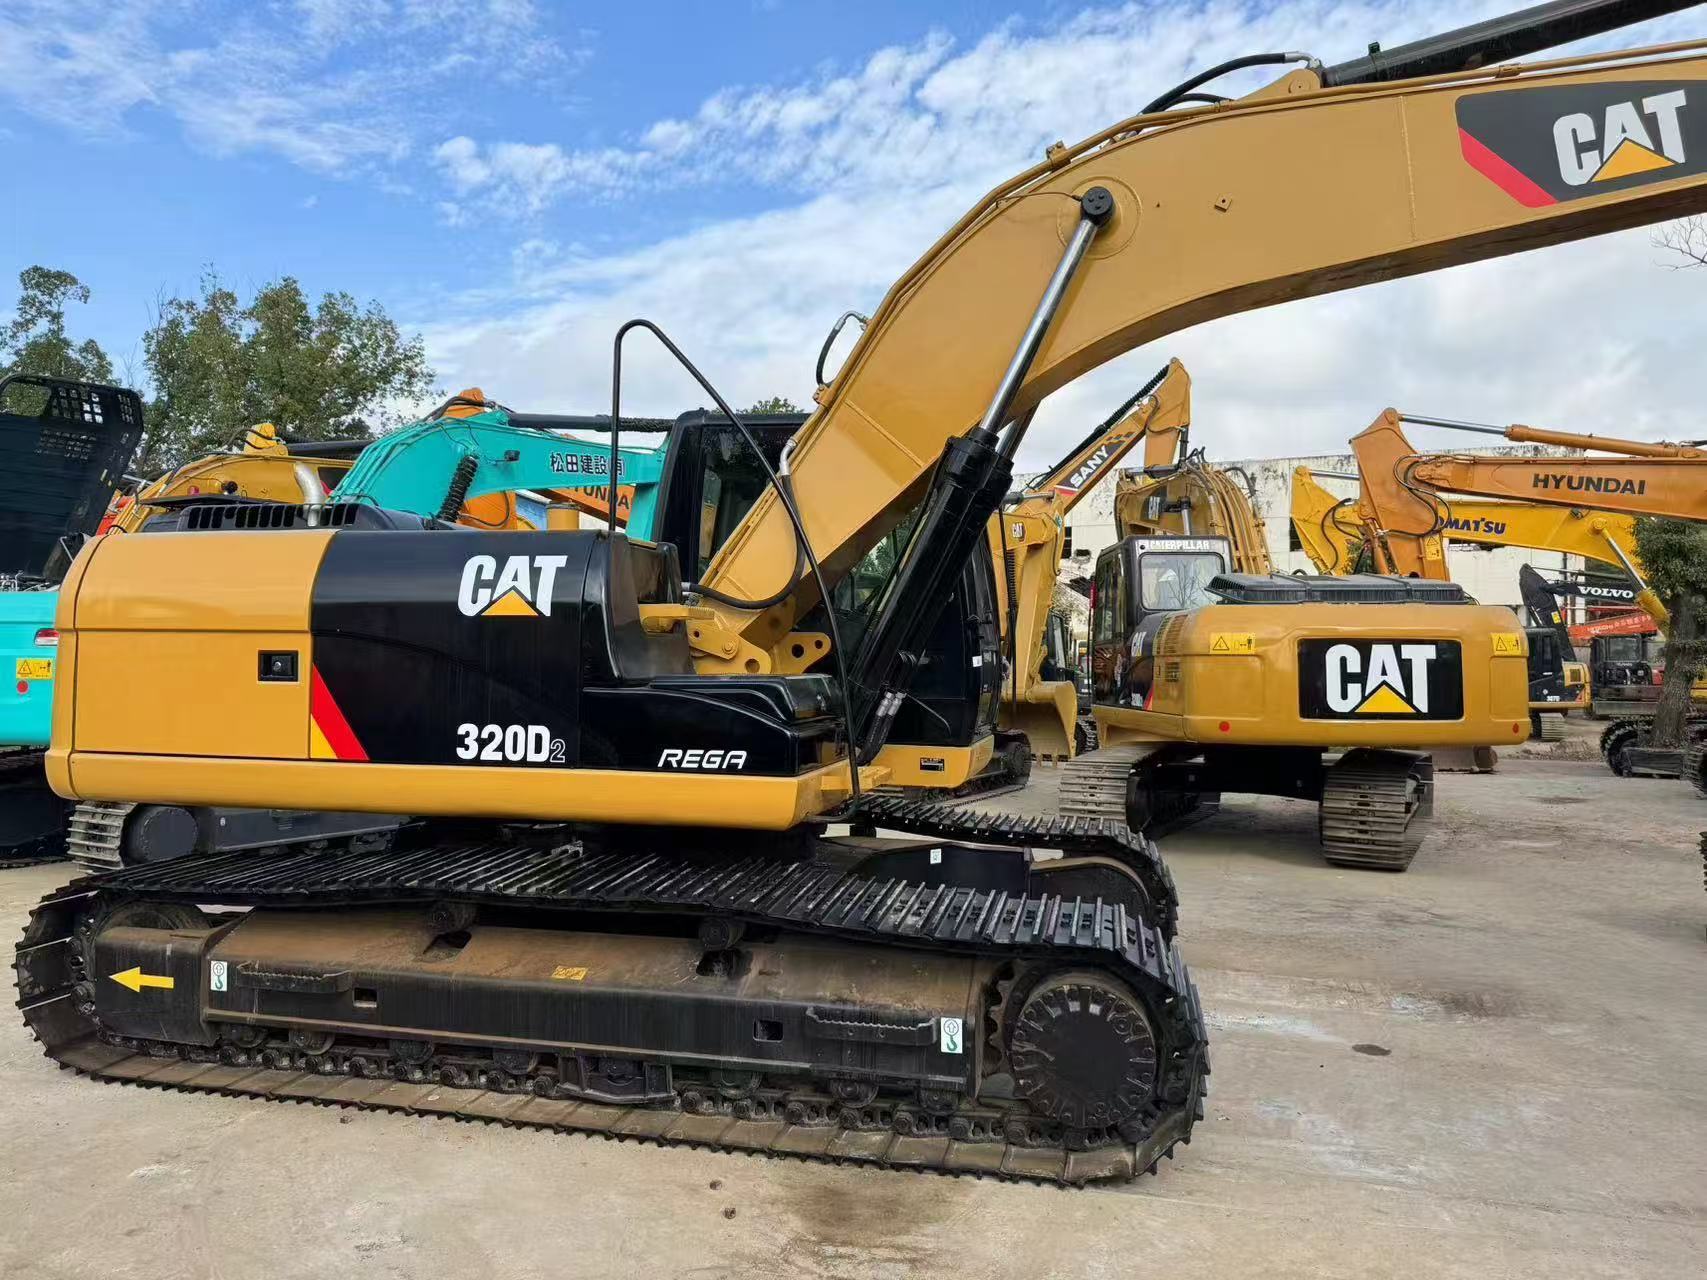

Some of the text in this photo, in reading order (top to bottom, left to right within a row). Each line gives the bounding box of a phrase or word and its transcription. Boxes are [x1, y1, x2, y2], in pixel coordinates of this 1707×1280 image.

[1553, 89, 1687, 186] CAT
[1070, 444, 1109, 488] SANY
[1532, 473, 1646, 495] HYUNDAI
[458, 554, 569, 617] CAT
[1577, 586, 1634, 599] VOLVO
[1325, 643, 1437, 713] CAT
[657, 748, 748, 770] REGA
